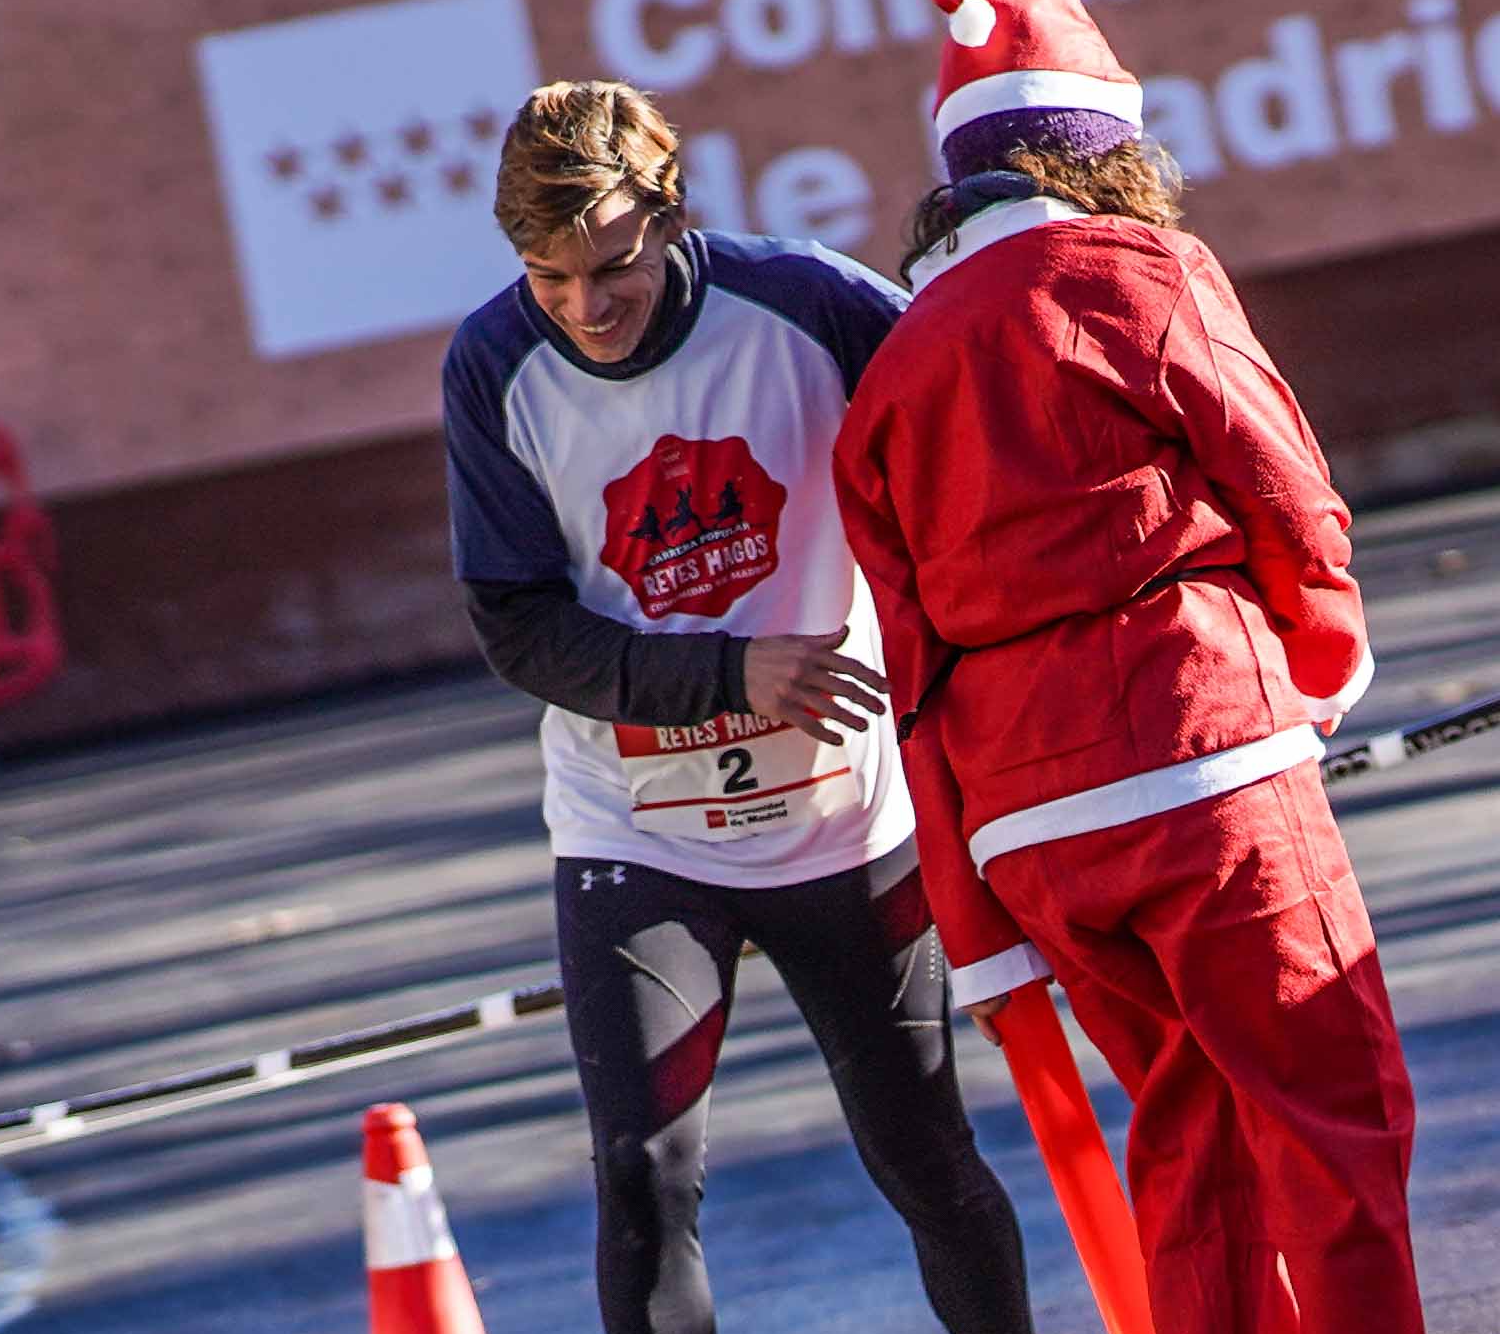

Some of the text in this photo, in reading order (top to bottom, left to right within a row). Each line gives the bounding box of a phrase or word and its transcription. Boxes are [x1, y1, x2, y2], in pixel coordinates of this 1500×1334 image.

[644, 534, 769, 596] REYES MAGOS
[655, 720, 719, 750] REYES
[717, 747, 759, 794] 2
